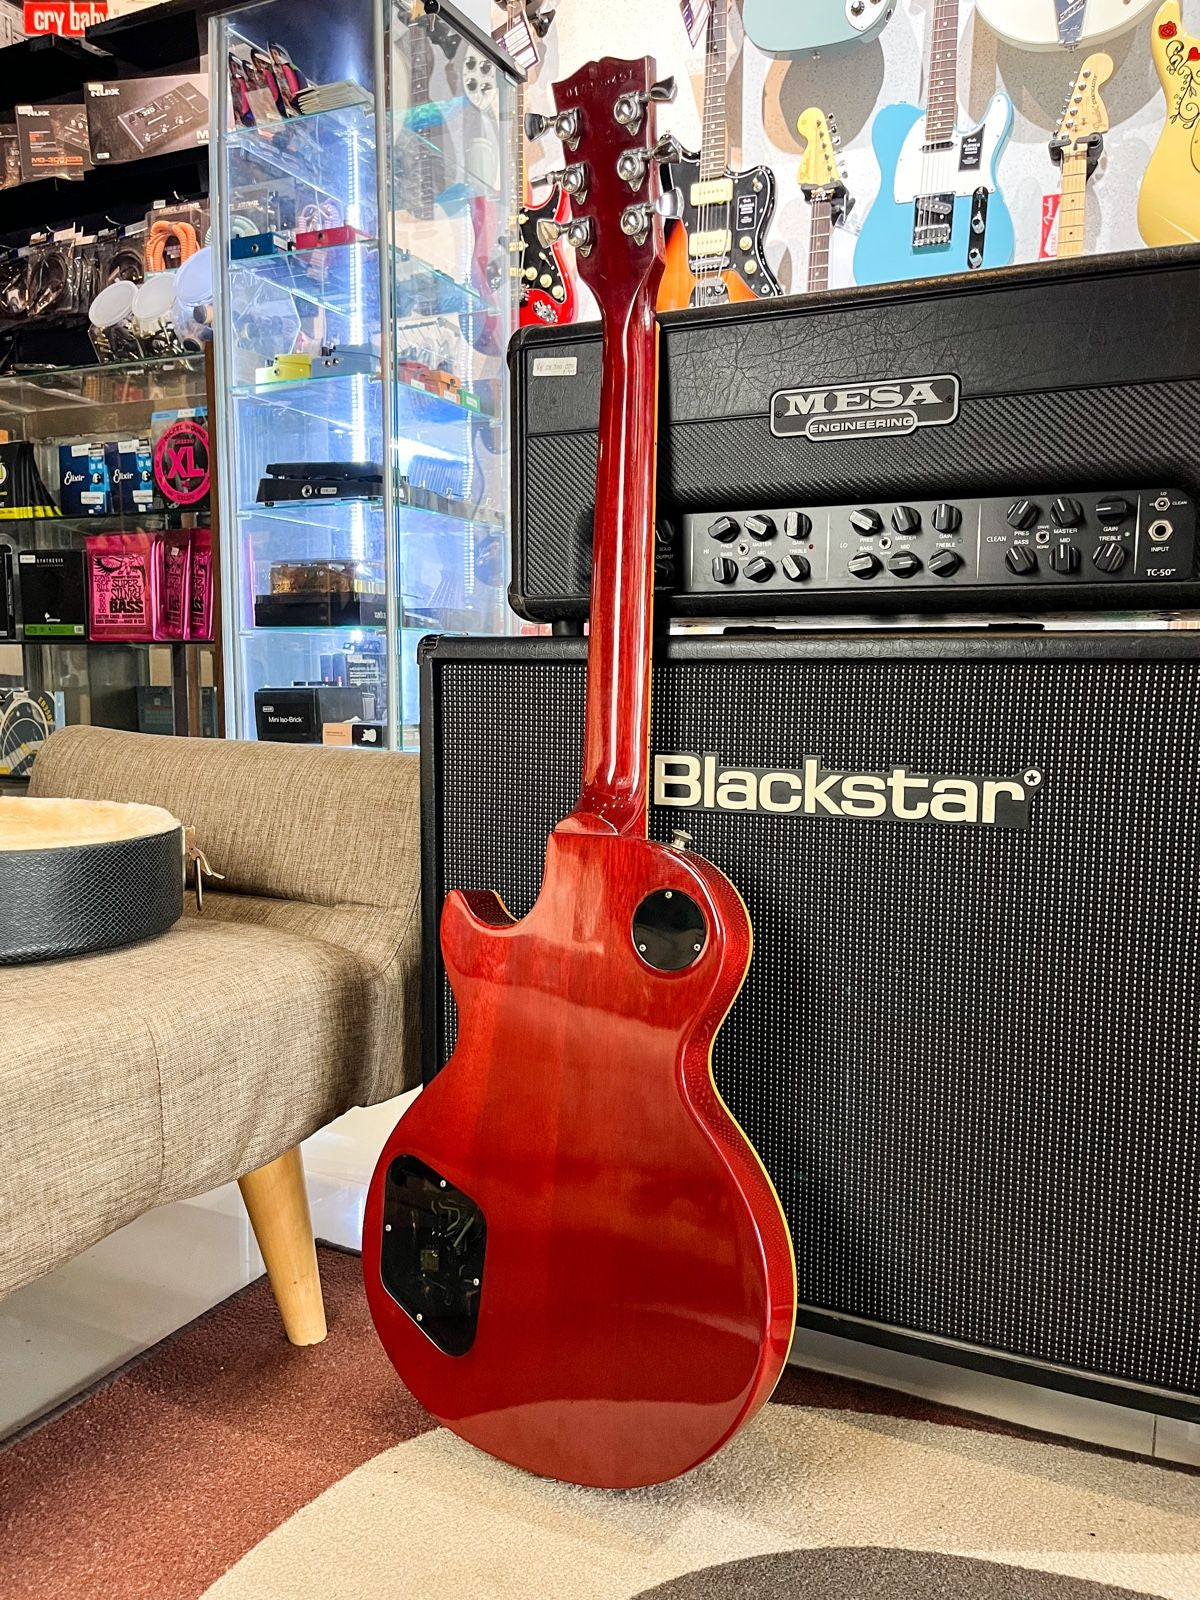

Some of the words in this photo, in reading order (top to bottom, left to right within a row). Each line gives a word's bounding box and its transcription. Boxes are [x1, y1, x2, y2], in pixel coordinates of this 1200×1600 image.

[34, 10, 65, 37] cry
[784, 382, 943, 416] MESA
[809, 416, 915, 434] ENGINEERING
[166, 446, 205, 479] XL
[64, 471, 85, 485] Elixir
[113, 469, 134, 484] Elixir
[110, 600, 144, 614] BASS
[654, 754, 1026, 824] Blackstar
